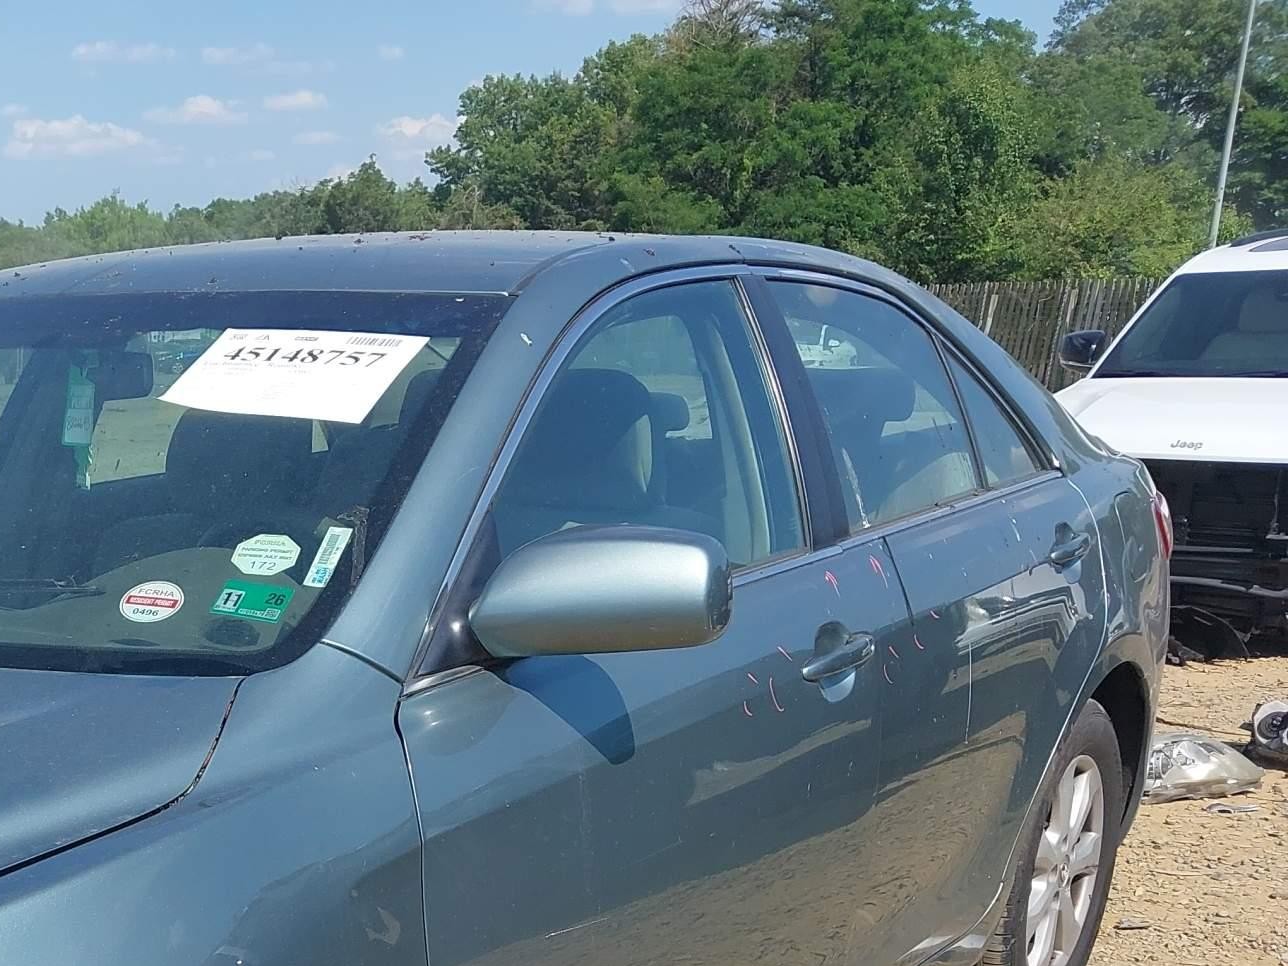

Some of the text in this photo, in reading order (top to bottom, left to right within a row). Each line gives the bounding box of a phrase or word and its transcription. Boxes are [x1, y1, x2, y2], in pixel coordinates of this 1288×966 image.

[224, 346, 388, 368] 45148757
[1170, 440, 1203, 451] Jeep
[249, 560, 277, 571] 172
[138, 588, 175, 597] FCRHA
[223, 592, 287, 607] 11 26
